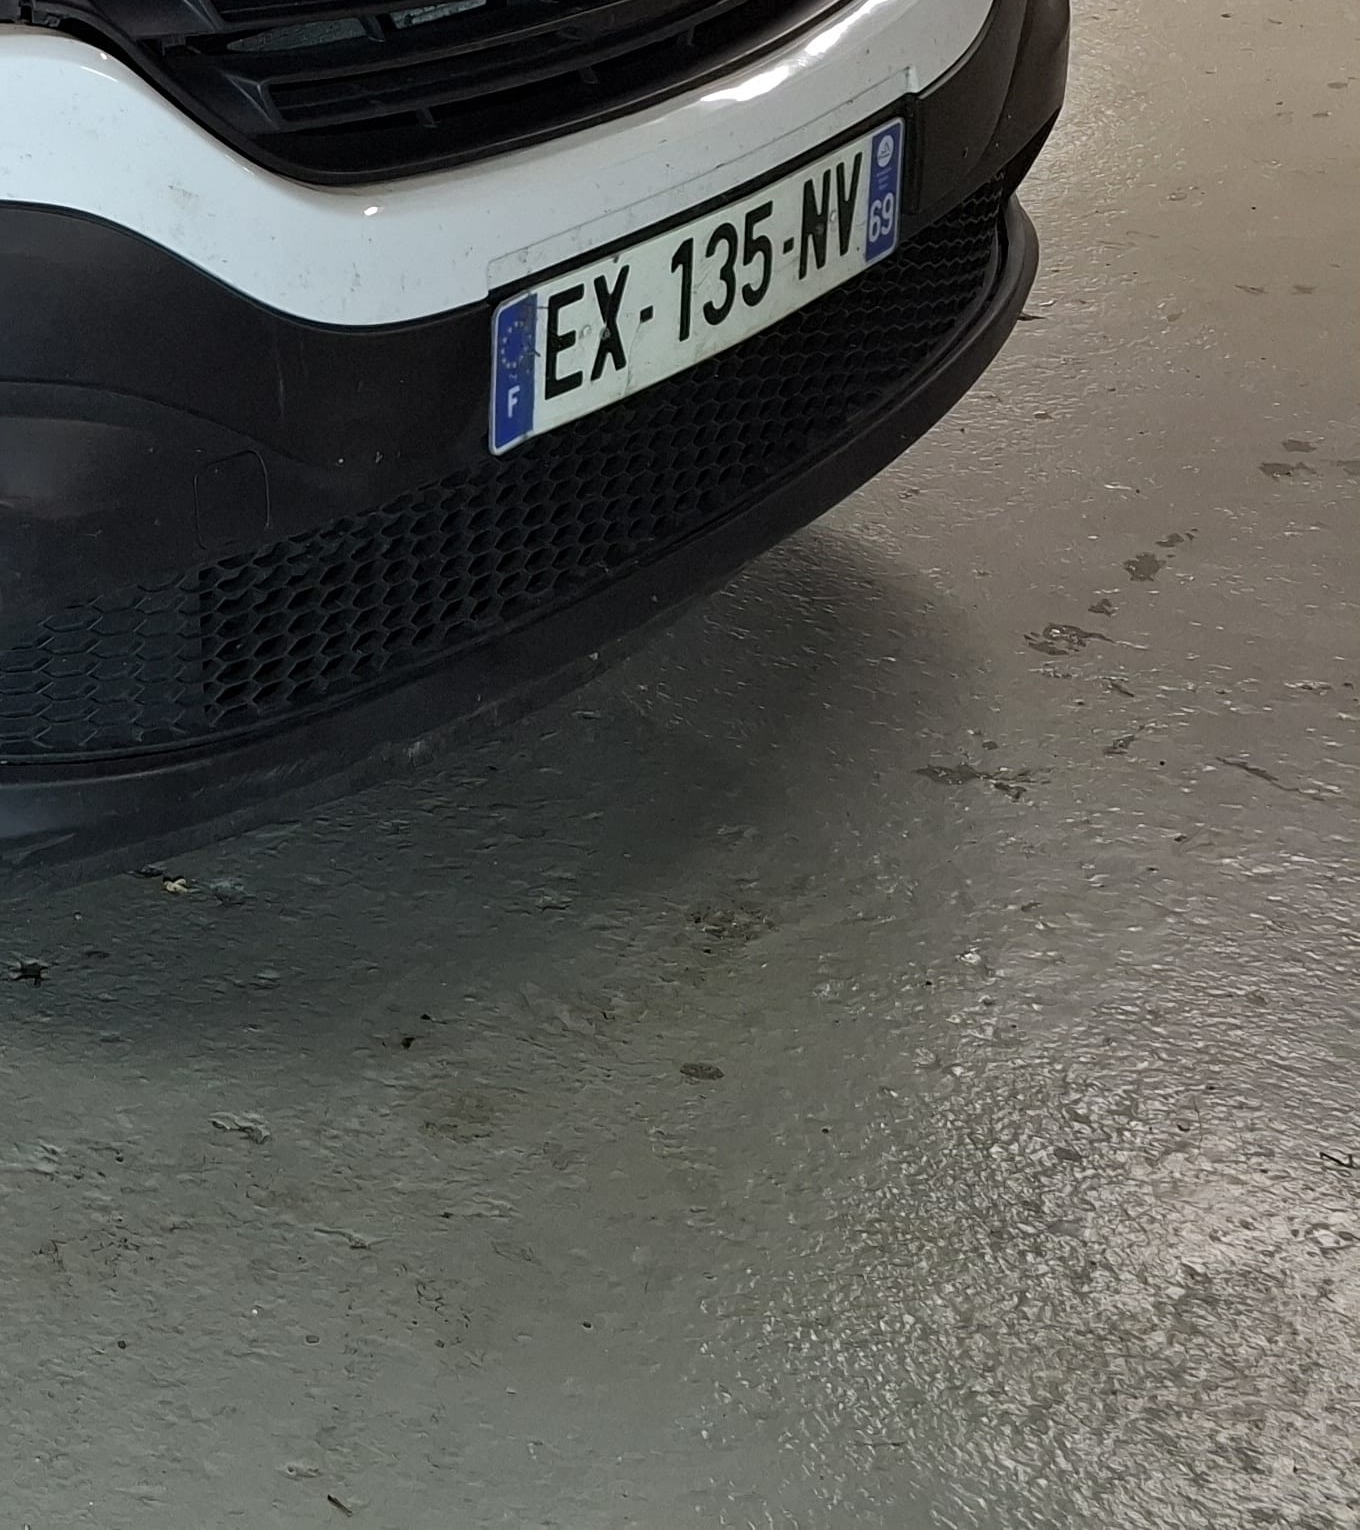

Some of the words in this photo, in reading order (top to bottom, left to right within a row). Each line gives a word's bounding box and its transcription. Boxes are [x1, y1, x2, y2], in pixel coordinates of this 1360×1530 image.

[868, 191, 895, 244] 69
[544, 151, 863, 401] EX-135-NV
[507, 385, 521, 419] F
